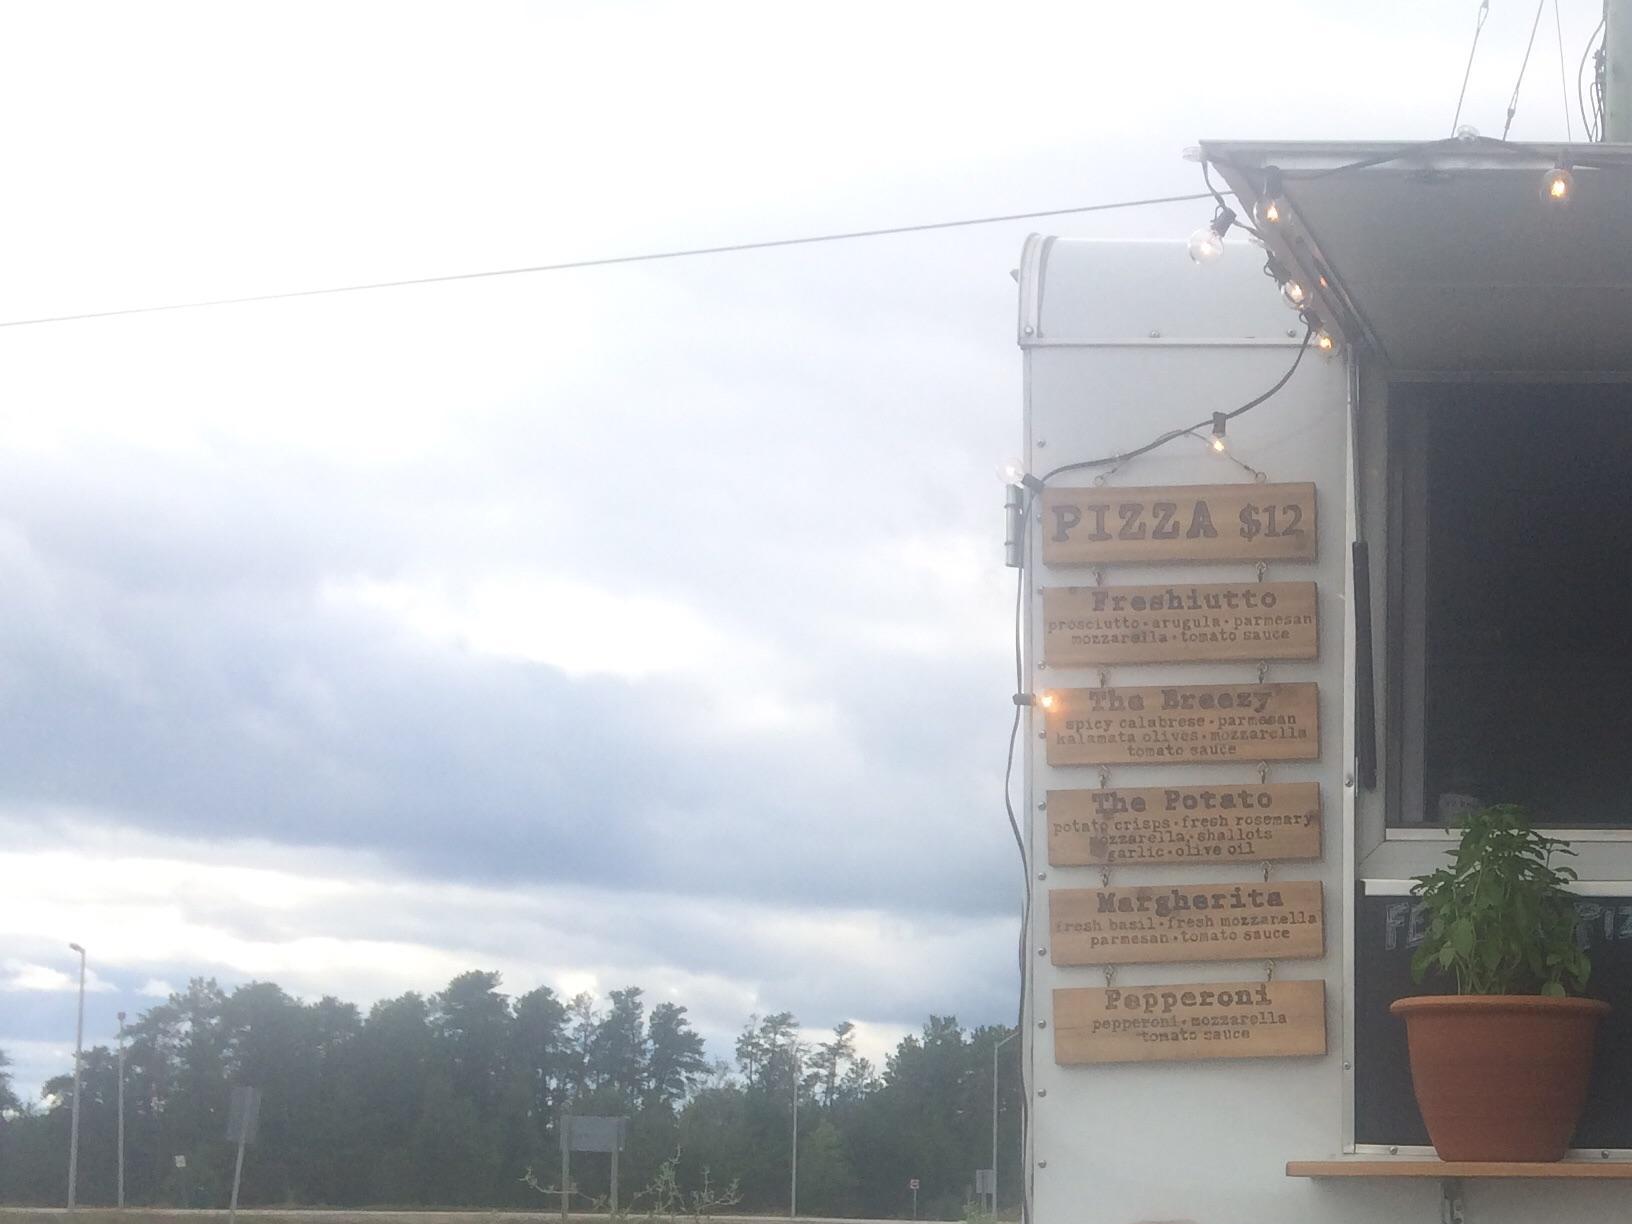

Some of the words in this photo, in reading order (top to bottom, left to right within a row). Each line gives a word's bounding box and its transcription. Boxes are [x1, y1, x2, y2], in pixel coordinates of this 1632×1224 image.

[1051, 500, 1218, 542] PIZZA
[1239, 503, 1304, 541] $12
[1091, 589, 1277, 612] Freshiutto
[1048, 617, 1139, 633] prosciutto
[1152, 615, 1222, 634] arugula
[1234, 614, 1312, 629] parmesan
[1072, 630, 1168, 645] mozzarella
[1181, 630, 1236, 642] tomato
[1243, 628, 1290, 641] sauce
[1088, 689, 1144, 712] The
[1161, 687, 1272, 713] Breezy
[1065, 718, 1111, 733] spicy
[1119, 716, 1205, 729] calabrese
[1219, 714, 1296, 729] parmesan
[1056, 730, 1135, 745] kalamata
[1142, 729, 1198, 743] olives
[1210, 726, 1307, 741] mozzarella
[1128, 743, 1184, 757] tomato
[1191, 742, 1236, 756] sauce
[1091, 791, 1146, 814] The
[1164, 789, 1272, 811] Potato
[1053, 820, 1108, 835] potato
[1115, 817, 1170, 831] crisps
[1183, 815, 1228, 828] fresh
[1236, 813, 1313, 828] rosemary
[1197, 828, 1272, 841] shallots
[1107, 847, 1164, 862] garlic
[1176, 844, 1221, 857] olive
[1228, 841, 1255, 855] oil
[1096, 887, 1284, 917] Margherita
[1057, 919, 1101, 933] fresh
[1109, 917, 1154, 931] basil
[1168, 915, 1213, 930] fresh
[1220, 912, 1317, 927] mozzarella
[1090, 933, 1169, 949] parmesan
[1181, 929, 1237, 943] tomato
[1243, 927, 1290, 940] sauce
[1105, 984, 1272, 1013] Pepperoni
[1093, 1016, 1177, 1033] pepperoni
[1191, 1012, 1287, 1027] mozzarella
[1139, 1029, 1197, 1043] tomato
[1204, 1028, 1250, 1041] sauce
